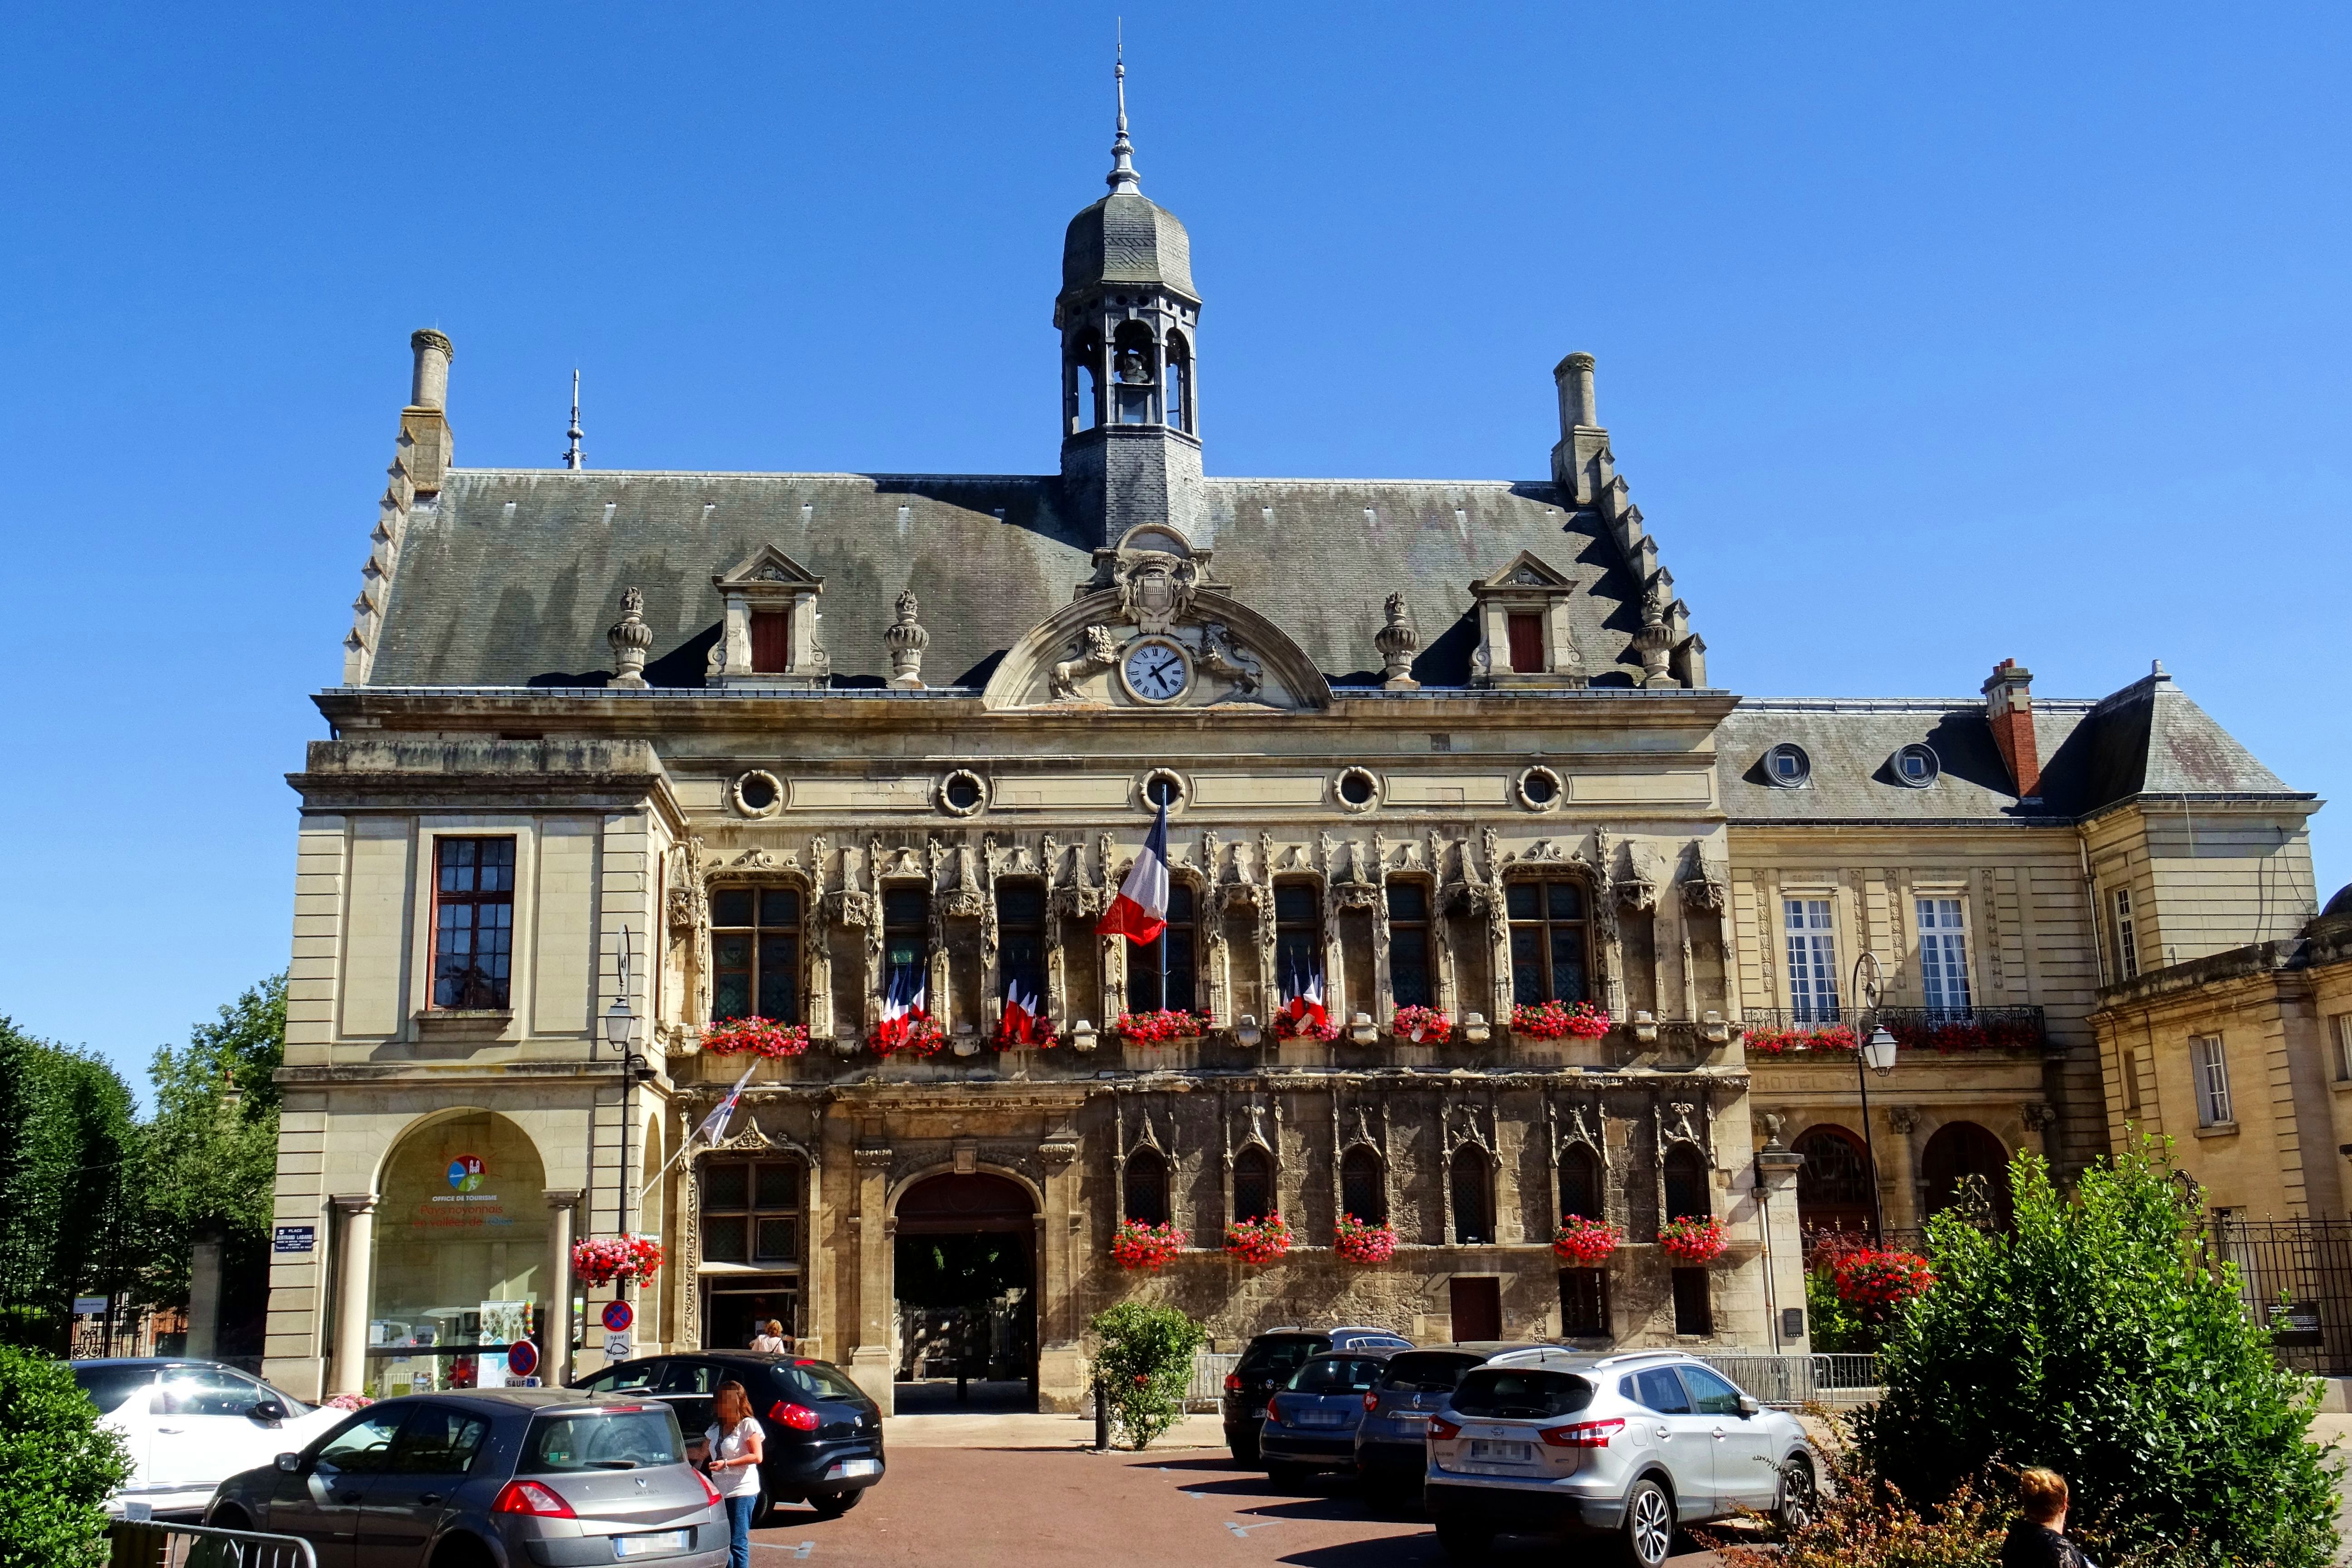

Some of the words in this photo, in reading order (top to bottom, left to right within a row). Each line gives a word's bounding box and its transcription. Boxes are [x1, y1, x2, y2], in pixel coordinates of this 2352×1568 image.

[1844, 1075, 1906, 1088] VLLE
[420, 1205, 446, 1215] Pays
[449, 1205, 503, 1215] noyonnais
[469, 1217, 482, 1226] de
